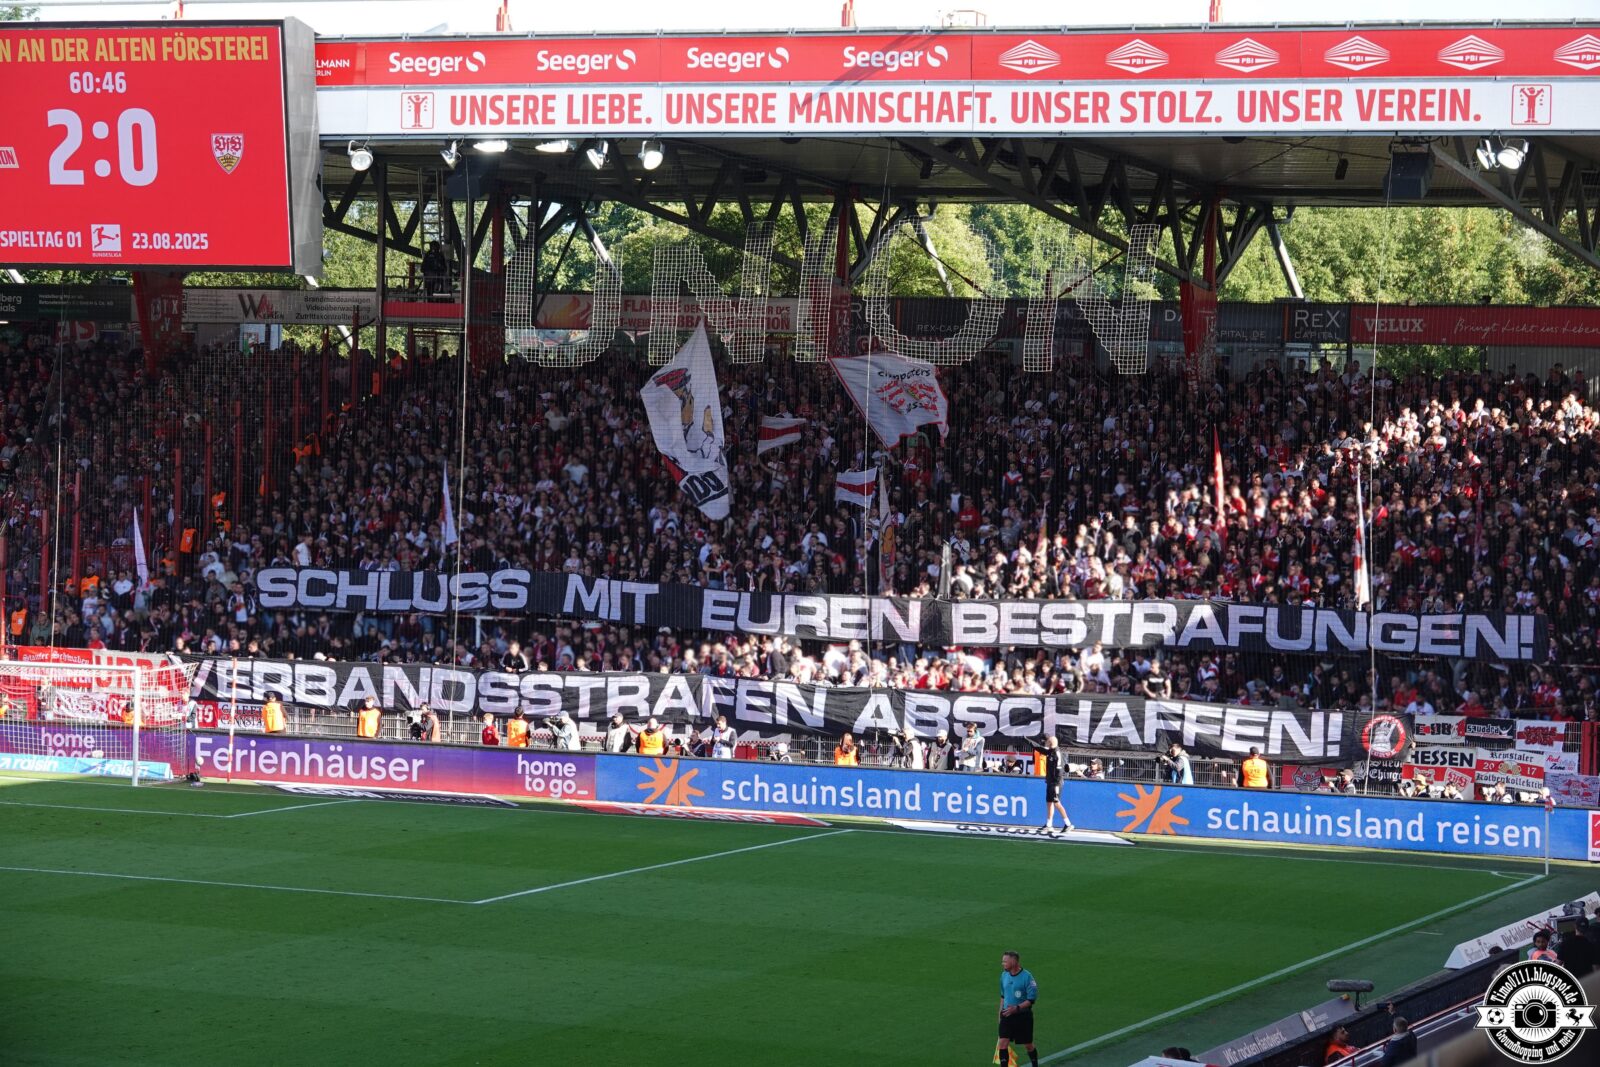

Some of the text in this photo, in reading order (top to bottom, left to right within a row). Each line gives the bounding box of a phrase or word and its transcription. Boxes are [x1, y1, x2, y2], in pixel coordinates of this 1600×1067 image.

[18, 38, 45, 62] AN
[51, 38, 89, 62] DER
[94, 37, 156, 62] ALTEN
[162, 32, 269, 61] FÖRSTEREI
[843, 46, 923, 72] Seeger
[1580, 53, 1596, 61] PBI
[388, 51, 464, 77] Seeger
[536, 49, 613, 75] Seeger
[686, 47, 765, 73] Seeger
[69, 71, 127, 93] 60:46
[449, 88, 1482, 126] UNSERE LIEBE. UNSERE MANNSCHAFT. UNSER STOLZ. UNSER VEREIN.
[47, 107, 158, 187] 2:0
[0, 230, 82, 249] SPIELTAG 01
[132, 232, 209, 250] 23.08.2025
[1294, 331, 1339, 339] CAPITAL
[1364, 318, 1424, 333] VELUX
[256, 568, 1535, 661] SCHLUSS MIT EUREN BESTRAFUNGEN!
[168, 653, 829, 729] VERBANDSSTRAFEN
[851, 691, 1343, 758] ABSCHAFFEN!
[41, 727, 96, 749] home
[195, 734, 426, 783] Ferienhäuser
[517, 754, 577, 778] home
[1410, 750, 1474, 768] HESSEN
[1482, 762, 1495, 770] 20
[1527, 766, 1537, 775] 17
[524, 773, 545, 792] to
[721, 773, 1028, 818] schauinsland reisen
[1207, 801, 1541, 849] schauinsland reisen
